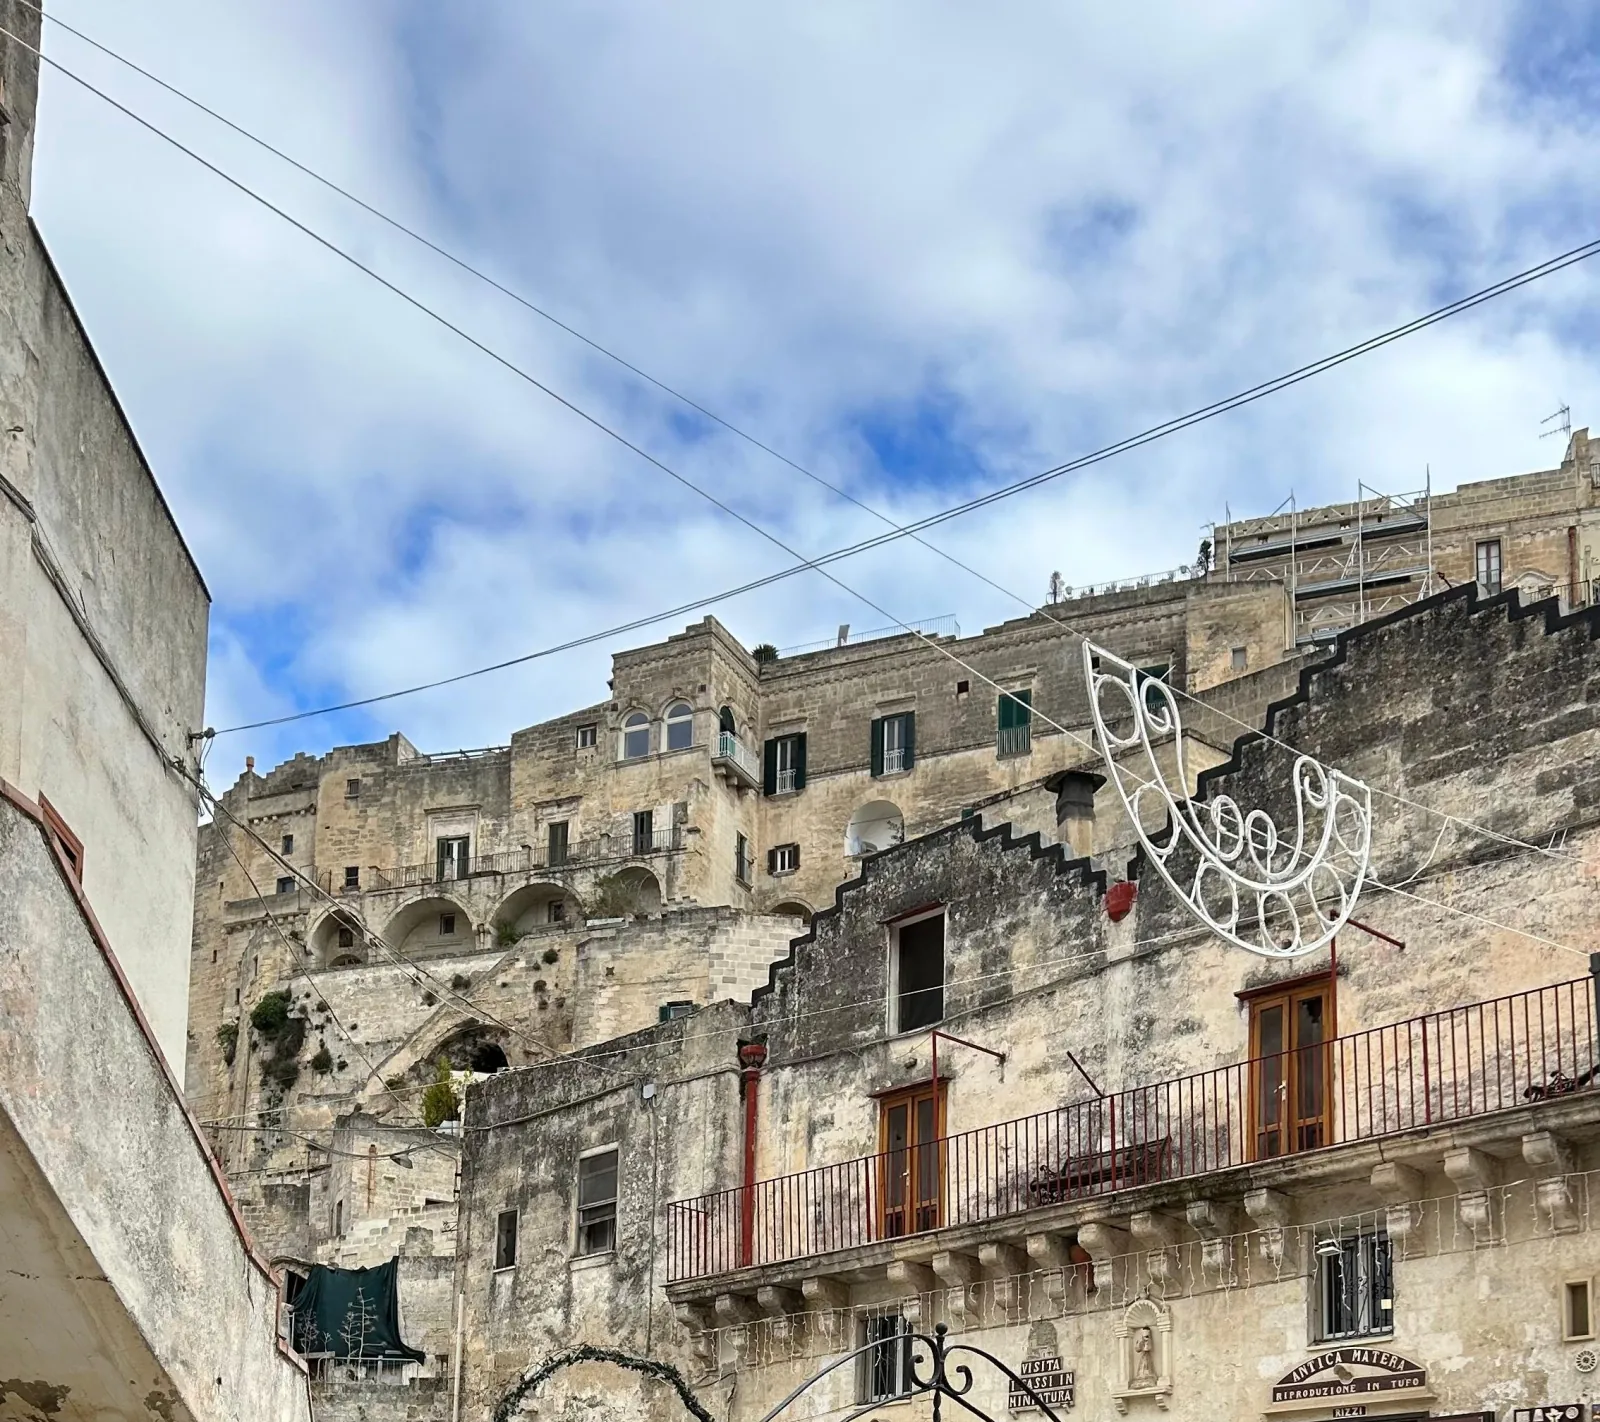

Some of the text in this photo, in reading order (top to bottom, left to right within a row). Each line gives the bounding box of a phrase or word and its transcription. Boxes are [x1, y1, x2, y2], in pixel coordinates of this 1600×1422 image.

[1022, 1359, 1060, 1374] VISITA
[1292, 1349, 1406, 1382] ANTICA MATERA
[1011, 1380, 1015, 1391] I
[1060, 1373, 1073, 1385] IN
[1275, 1378, 1420, 1401] RIPRODUZIONE IN TUFO
[1335, 1407, 1363, 1417] RIZZI
